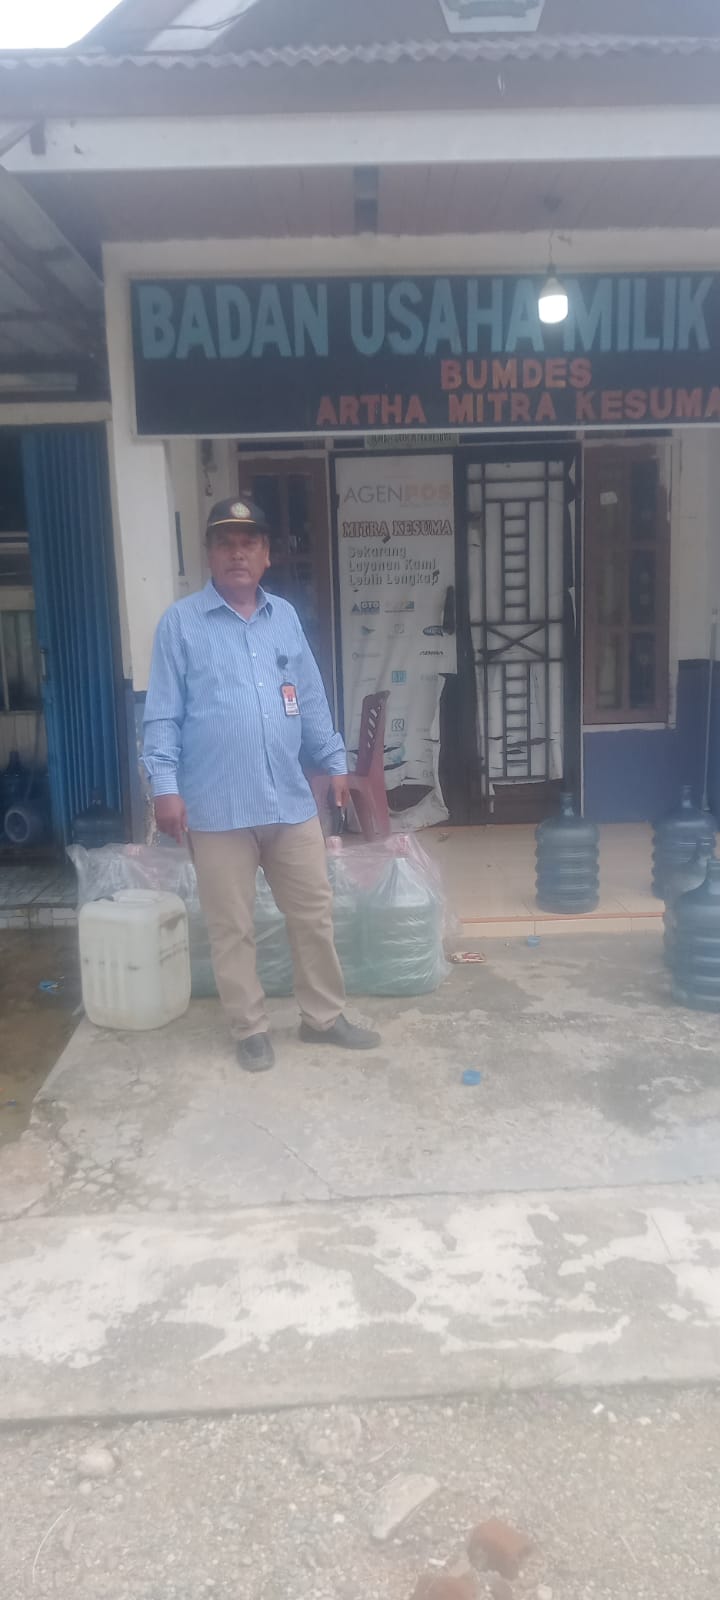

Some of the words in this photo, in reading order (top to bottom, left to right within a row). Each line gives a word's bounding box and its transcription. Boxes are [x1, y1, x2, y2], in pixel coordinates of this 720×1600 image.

[138, 284, 328, 359] BADAN
[349, 280, 545, 355] USAHA
[563, 277, 711, 352] MILIK
[440, 358, 592, 390] BUMDES
[317, 395, 426, 426] ARTHA
[448, 391, 555, 424] MITRA
[575, 387, 720, 421] KESUMA
[343, 521, 390, 538] MITRA
[392, 519, 453, 537] KESUMA
[348, 545, 407, 559] Sekarang
[348, 559, 401, 576] Layanan
[405, 557, 437, 571] Kami
[349, 573, 383, 587] Lebih
[387, 571, 440, 587] Lengkap
